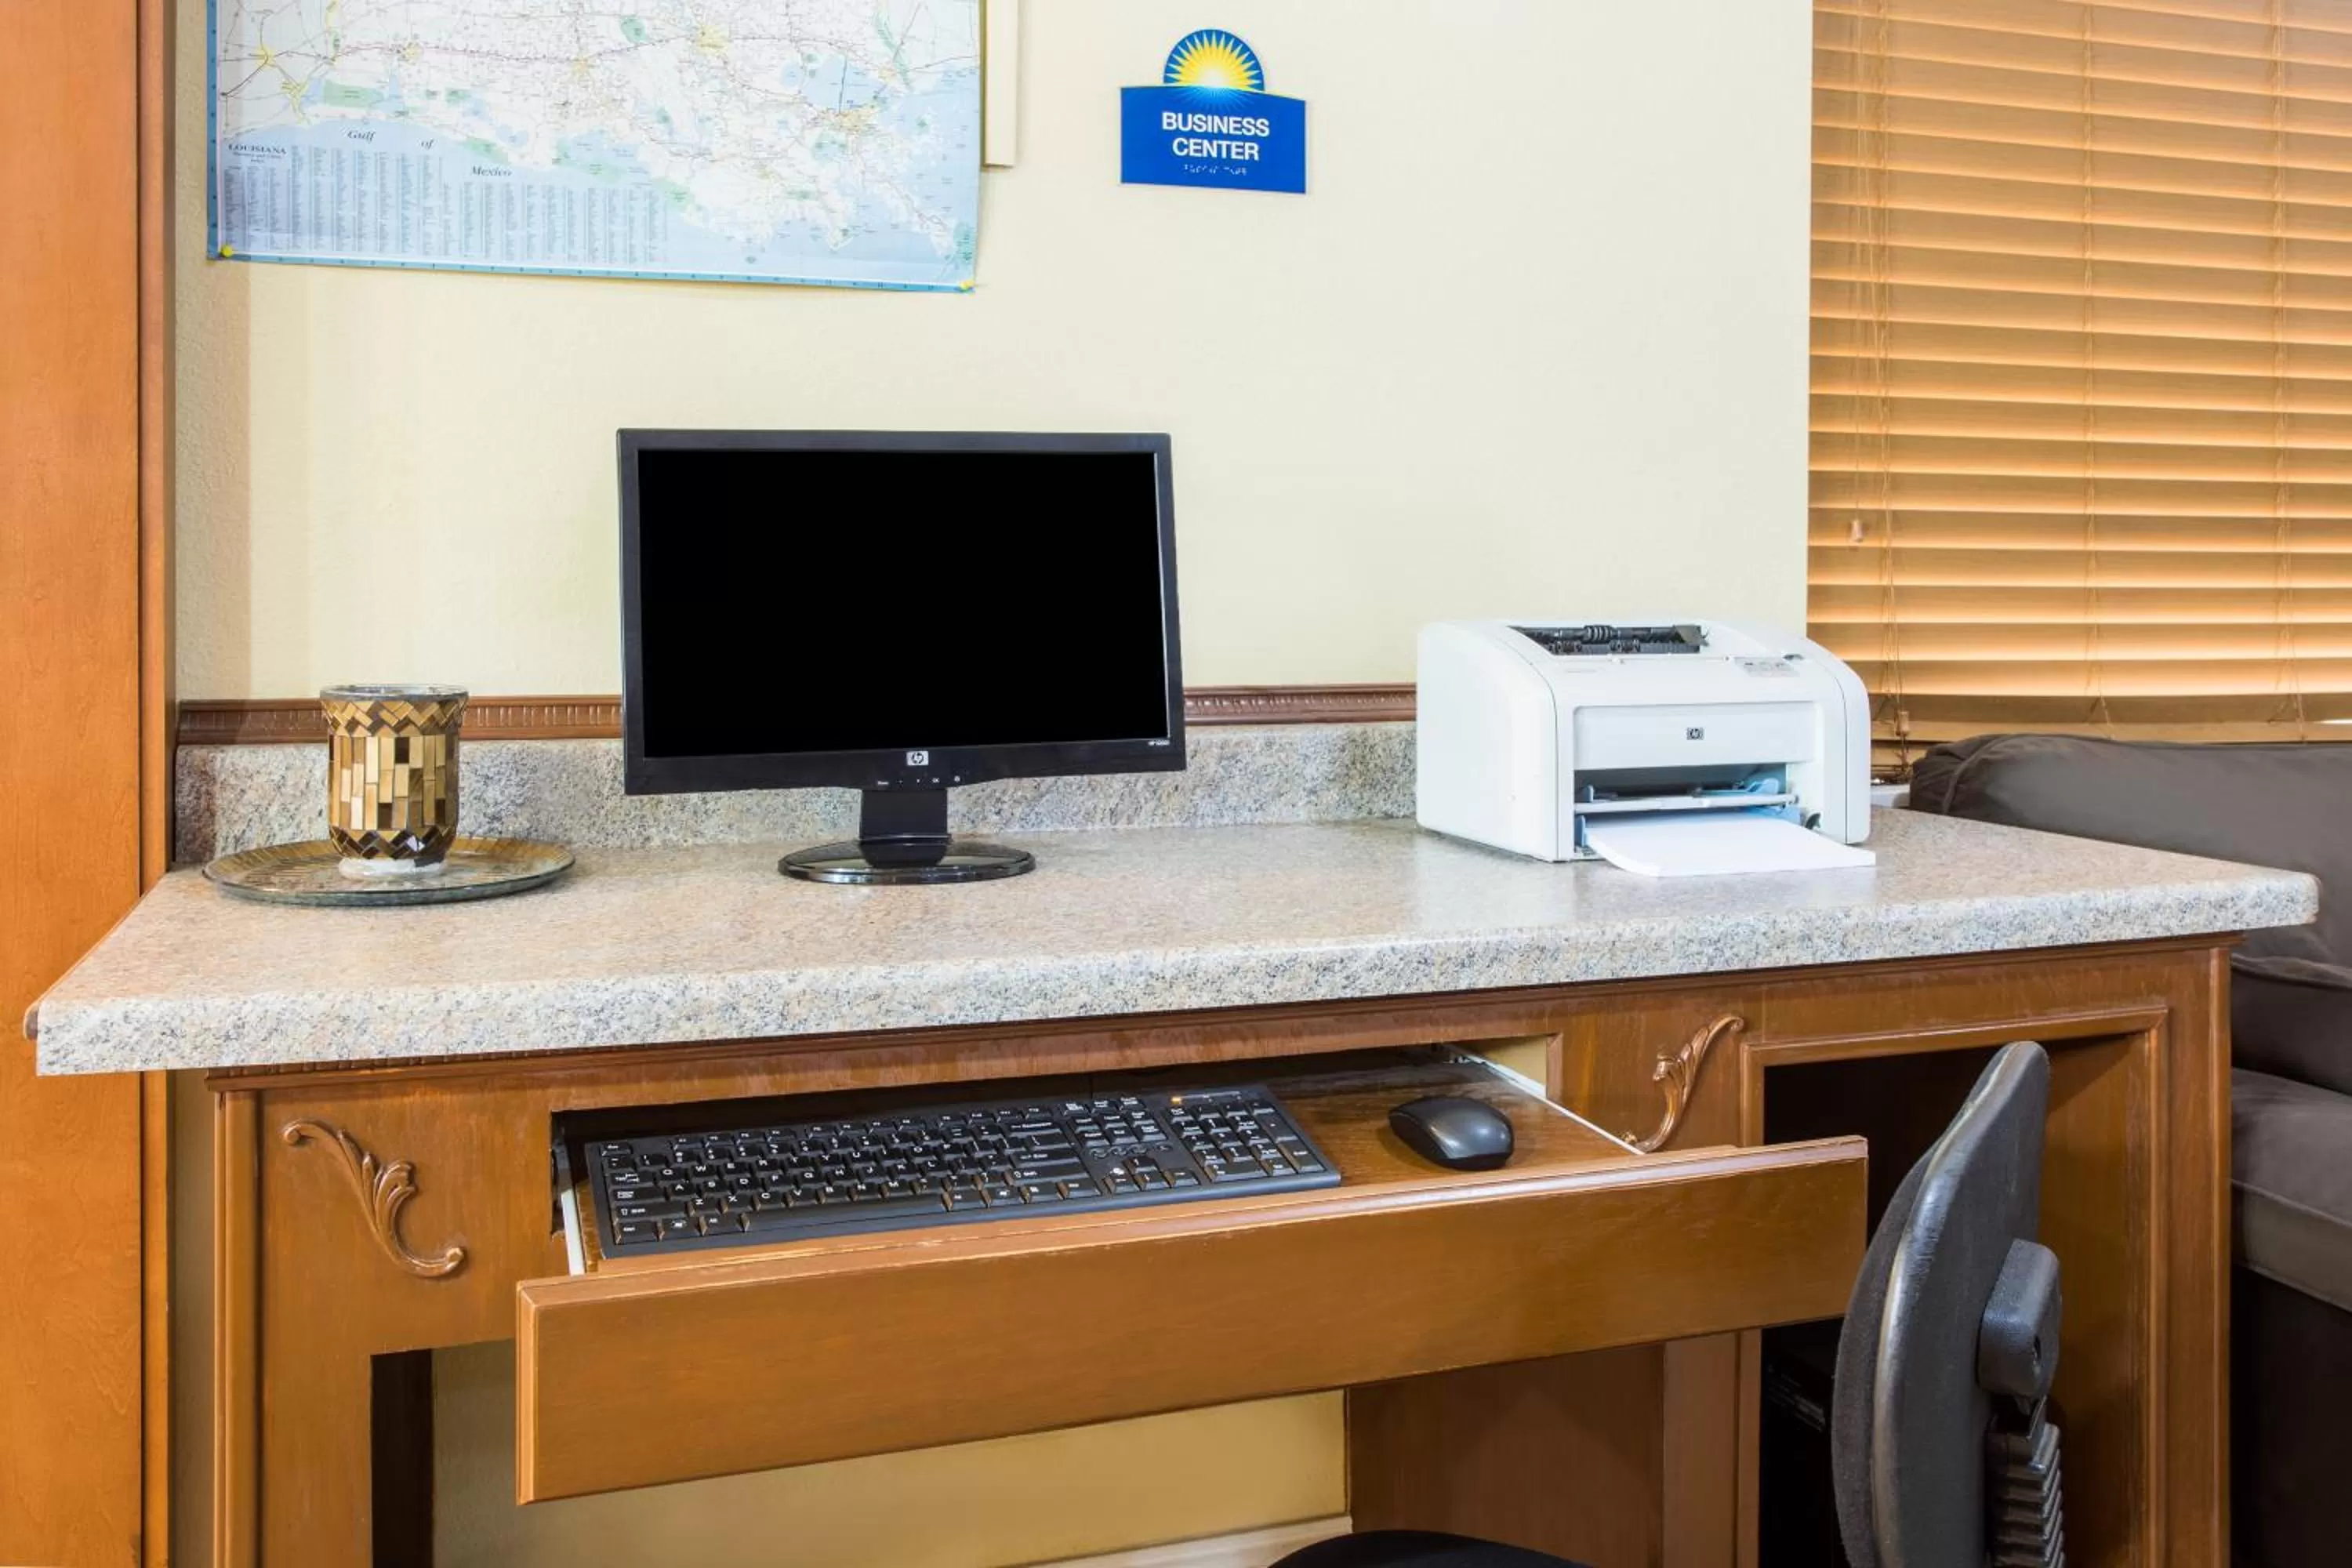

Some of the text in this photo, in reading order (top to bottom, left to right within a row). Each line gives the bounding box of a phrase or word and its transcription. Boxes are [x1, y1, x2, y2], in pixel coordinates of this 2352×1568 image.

[347, 131, 376, 143] Gulf
[1161, 111, 1270, 138] BUSINESS
[1171, 137, 1260, 162] CENTER
